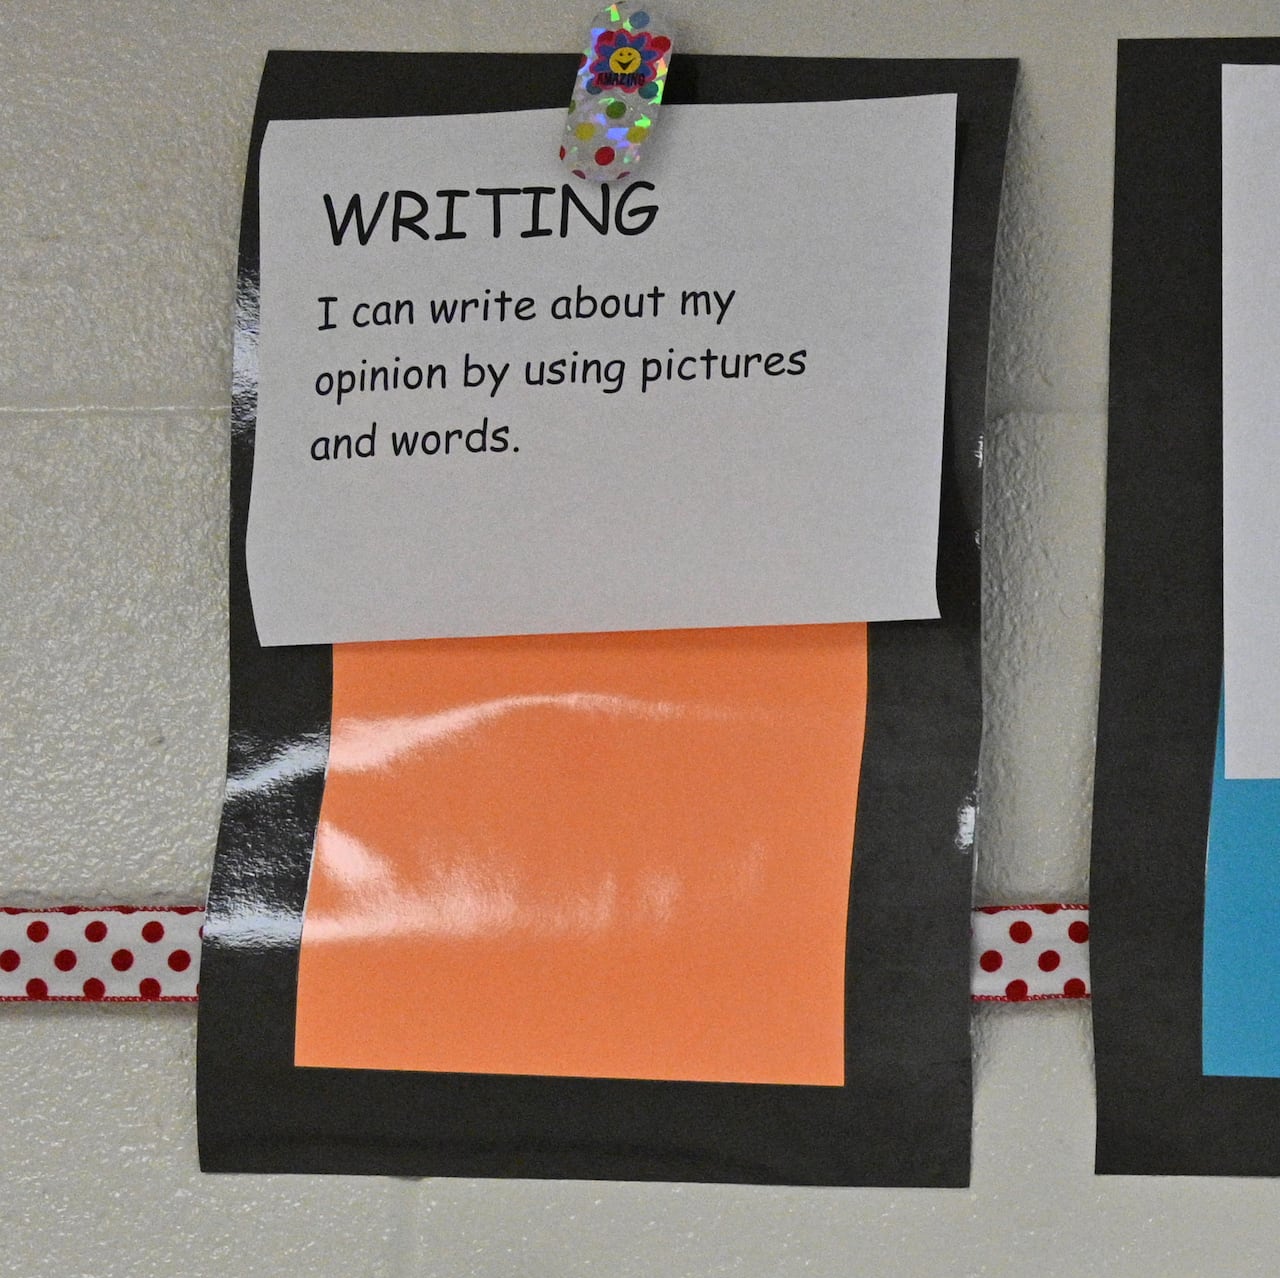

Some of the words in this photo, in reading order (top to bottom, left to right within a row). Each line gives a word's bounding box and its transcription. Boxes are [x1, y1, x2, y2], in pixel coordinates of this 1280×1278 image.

[323, 181, 659, 246] WRITING
[318, 297, 337, 330] I
[353, 300, 413, 327] can
[431, 289, 536, 323] write
[551, 285, 665, 319] about
[681, 290, 735, 324] my
[316, 357, 446, 405] opinion
[464, 353, 509, 397] by
[526, 351, 625, 393] using
[642, 348, 806, 393] pictures
[311, 422, 376, 460] and
[392, 417, 519, 456] words.
